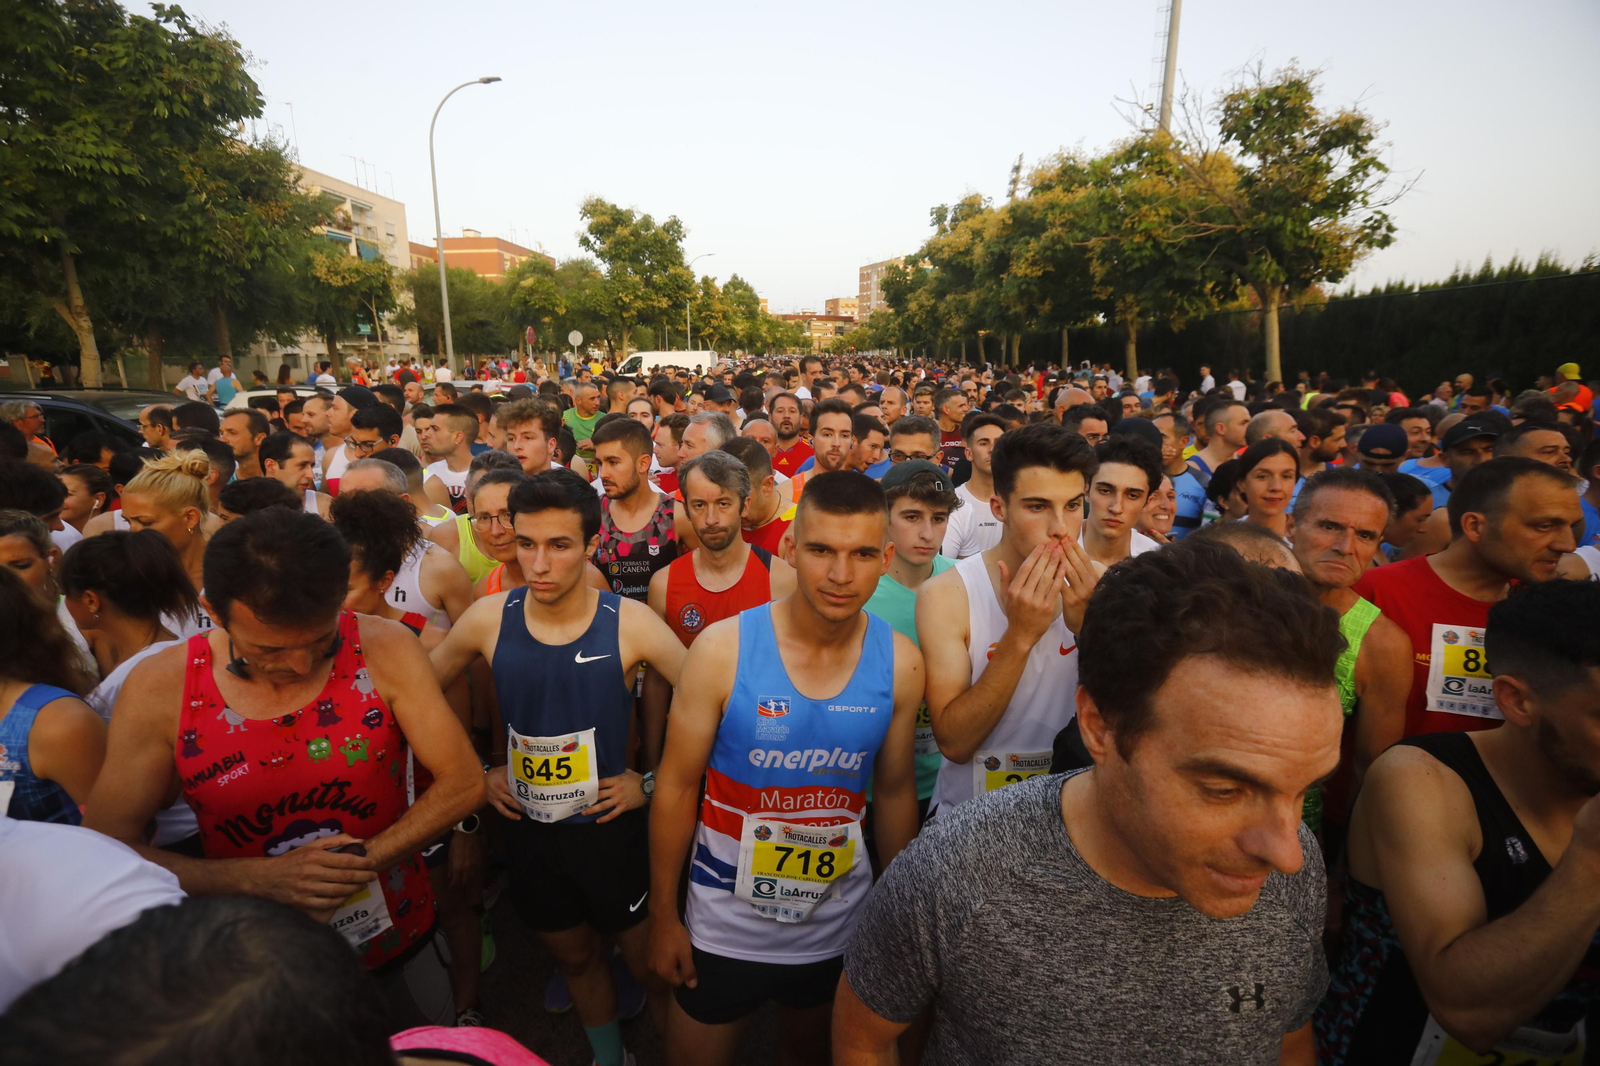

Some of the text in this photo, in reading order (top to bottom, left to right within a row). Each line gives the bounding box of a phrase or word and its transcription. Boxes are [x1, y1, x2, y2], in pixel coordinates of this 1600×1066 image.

[757, 718, 776, 726] Club
[524, 744, 560, 752] TROTACALLES
[522, 757, 572, 781] 645
[749, 747, 868, 772] enerplus
[1013, 758, 1050, 767] TROTACALLES
[217, 763, 250, 787] SPORT
[531, 789, 585, 801] laArruzafa
[760, 789, 850, 810] Maratón
[214, 777, 378, 848] Monstruo
[784, 833, 827, 844] TROTACALLES
[775, 846, 835, 878] 718
